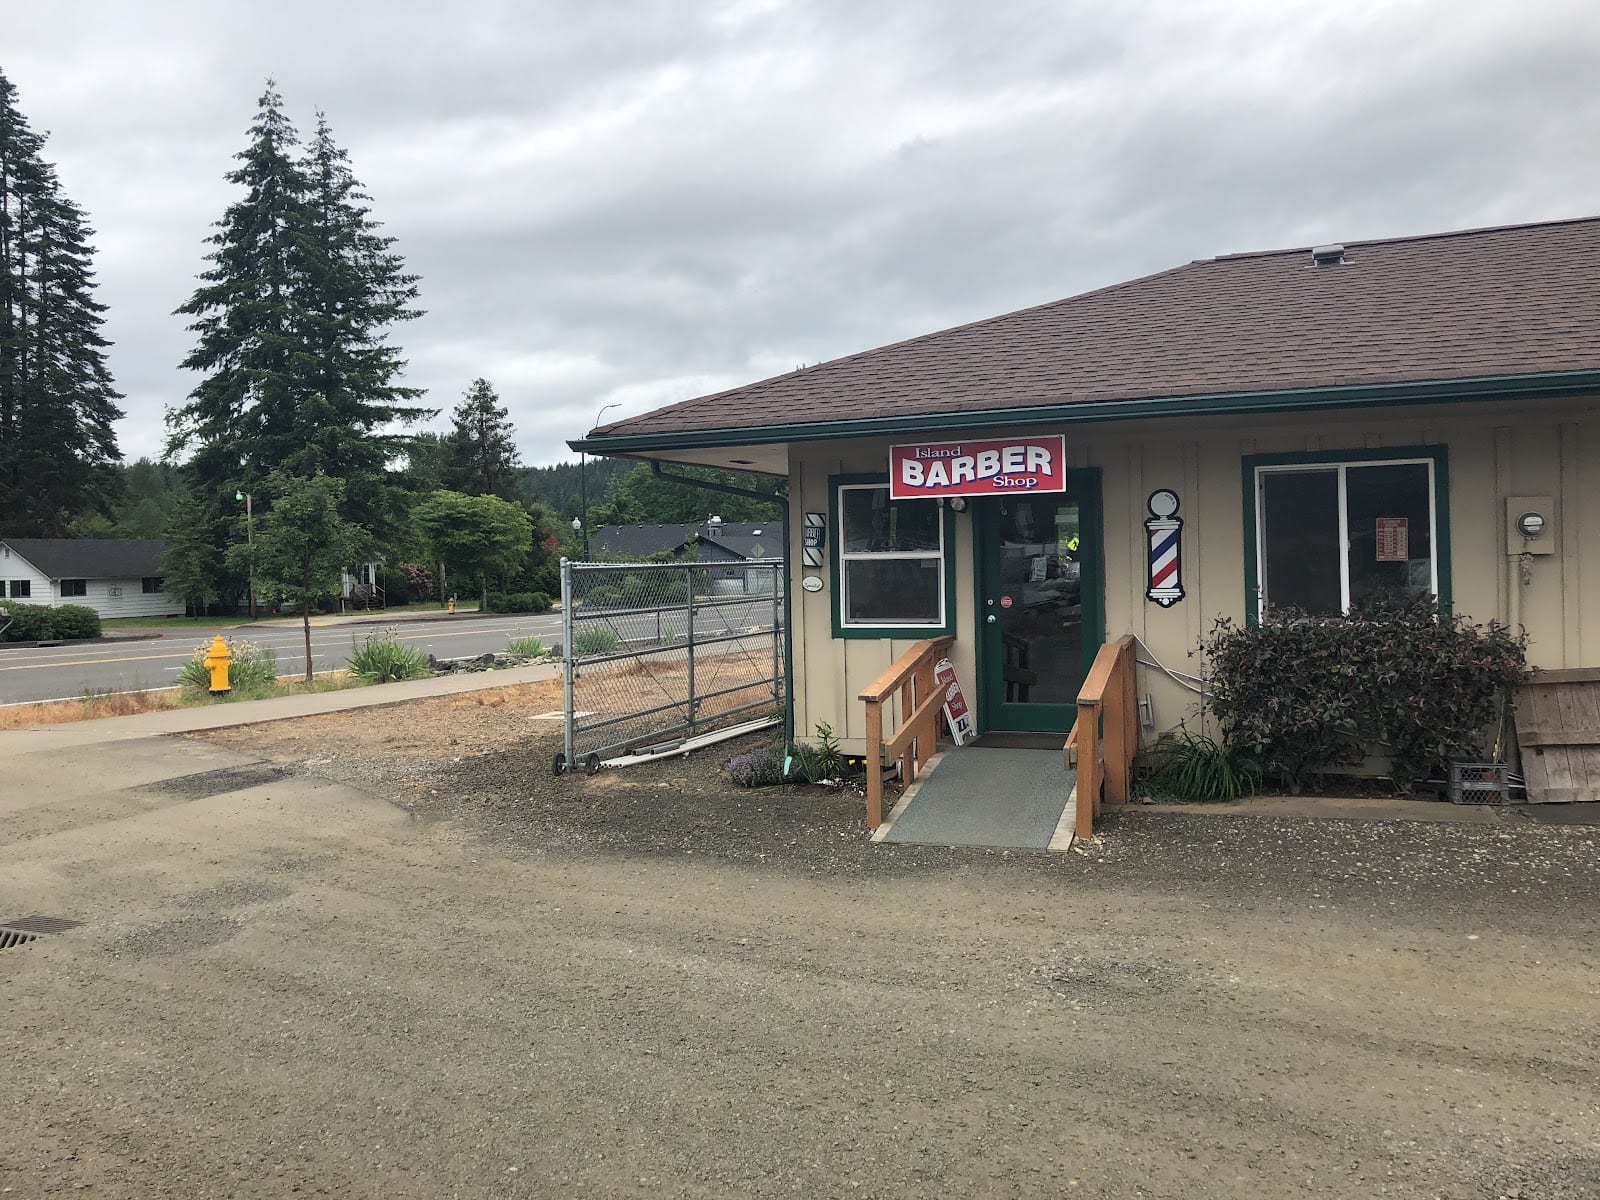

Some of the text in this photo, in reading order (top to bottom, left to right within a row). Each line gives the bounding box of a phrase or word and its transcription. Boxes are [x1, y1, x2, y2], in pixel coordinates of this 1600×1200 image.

[915, 445, 962, 459] Island
[902, 445, 1052, 487] BARBER
[992, 475, 1037, 489] Shop
